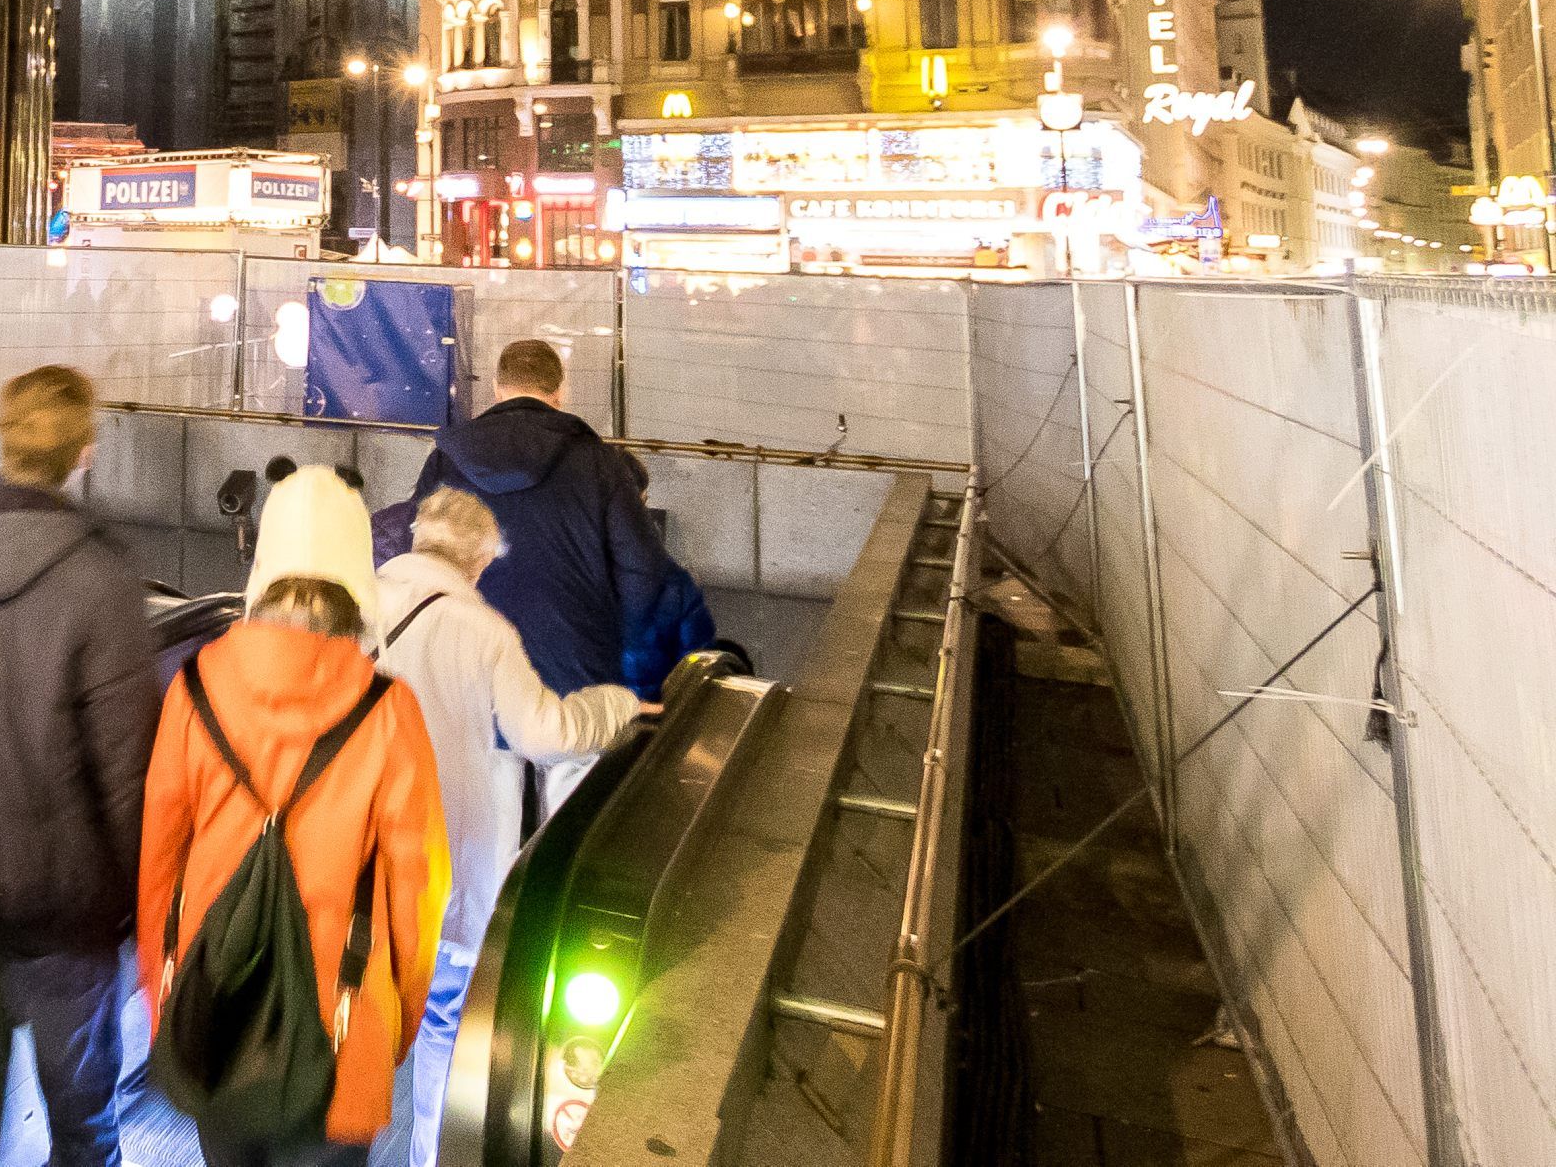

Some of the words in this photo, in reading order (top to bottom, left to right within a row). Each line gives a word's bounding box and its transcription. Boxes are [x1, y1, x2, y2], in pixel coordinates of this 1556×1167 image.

[1143, 80, 1256, 137] Royal
[105, 180, 179, 204] POLIZEI
[253, 180, 308, 198] POLIZEI
[790, 199, 852, 219] CAFE
